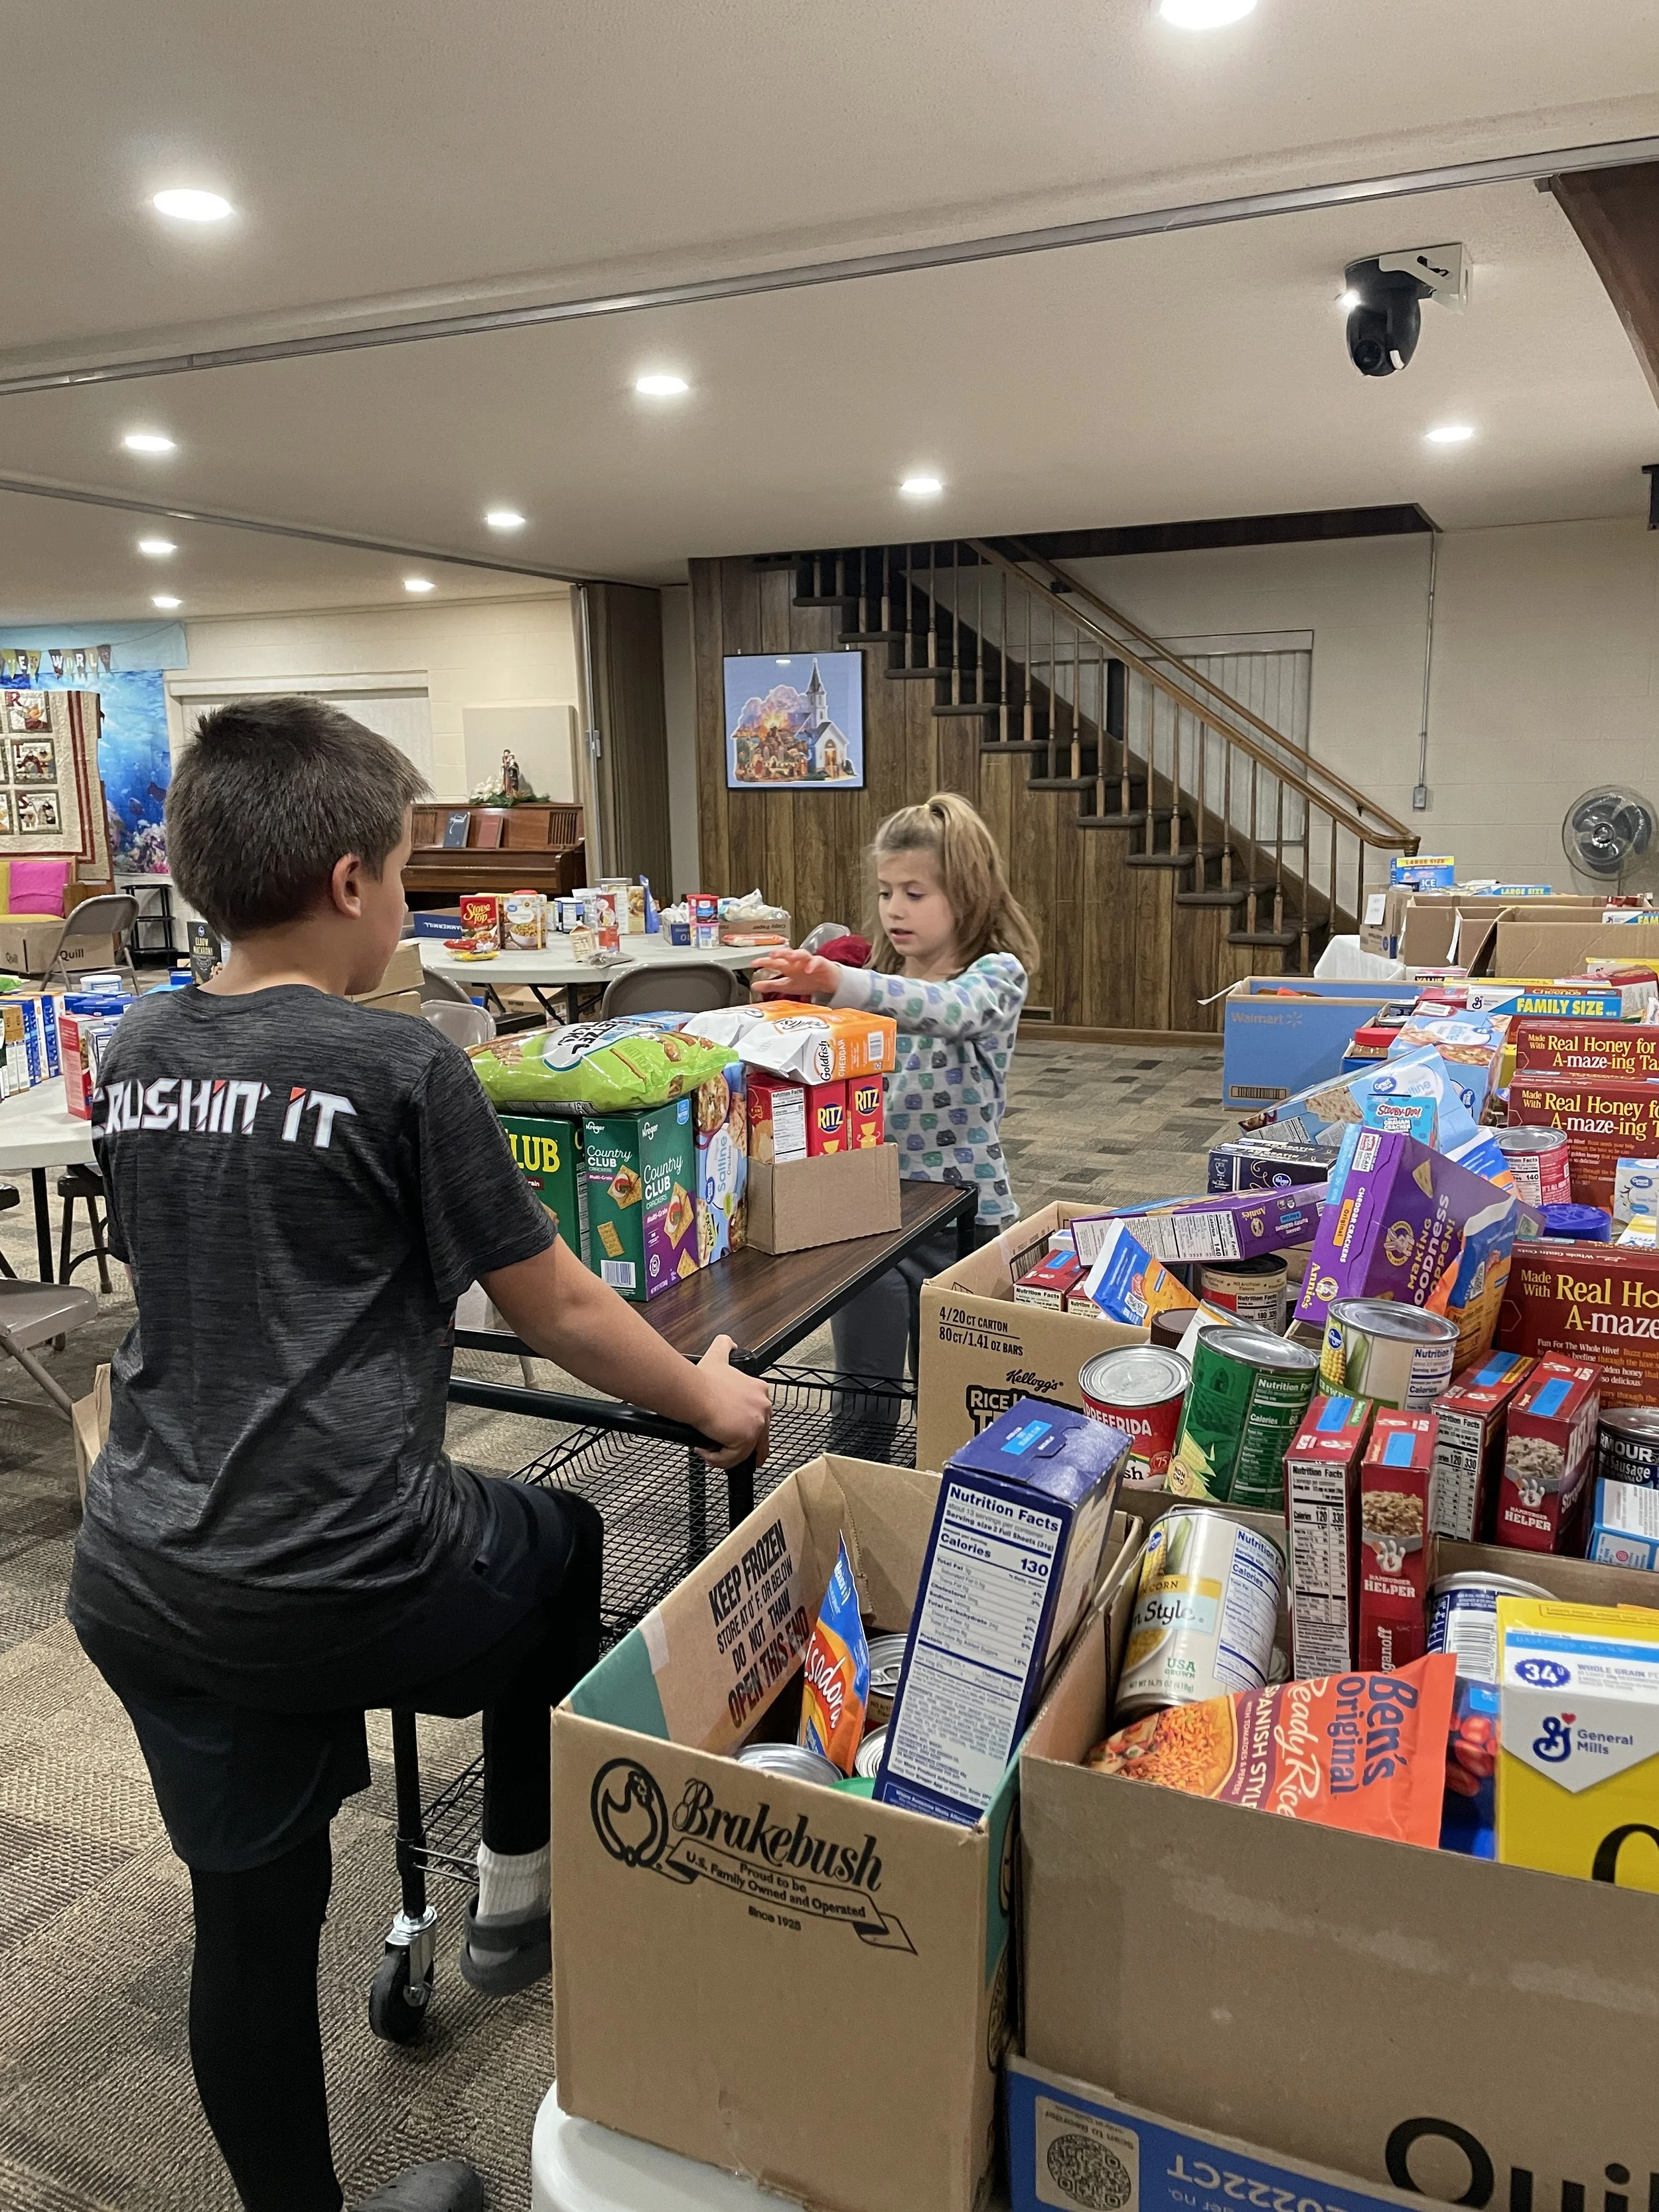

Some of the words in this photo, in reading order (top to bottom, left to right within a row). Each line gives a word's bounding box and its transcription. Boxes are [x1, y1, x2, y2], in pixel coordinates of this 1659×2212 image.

[463, 903, 491, 921] Stove
[473, 911, 488, 924] Top
[60, 950, 84, 962] Quill
[1517, 998, 1569, 1015] FAMILY
[1571, 1000, 1605, 1016] SIZE
[1231, 1012, 1283, 1024] Walmart
[1528, 1034, 1546, 1043] Made
[1530, 1041, 1546, 1050] With
[1548, 1035, 1579, 1052] Real
[1584, 1037, 1632, 1055] Honey
[1636, 1037, 1657, 1054] for
[820, 1040, 831, 1081] Goldfish
[1553, 1053, 1636, 1073] A-maze-ing
[855, 1088, 880, 1111] RITZ
[1522, 1090, 1542, 1100] Made
[1523, 1100, 1542, 1109] With
[1544, 1092, 1581, 1112] Real
[1587, 1096, 1645, 1120] Honey
[817, 1105, 843, 1129] RITZ
[1550, 1112, 1647, 1141] A-maze-ing
[585, 1121, 605, 1134] Kroger
[642, 1122, 658, 1140] Kroger
[506, 1129, 560, 1173] LUB
[587, 1145, 632, 1162] Country
[588, 1157, 616, 1167] CLUB
[644, 1155, 684, 1185] Country
[717, 1136, 727, 1192] Saltine
[644, 1175, 671, 1200] CLUB
[646, 1193, 668, 1210] CRACKERS
[1242, 1206, 1266, 1221] Annie's
[1336, 1209, 1349, 1238] Original
[1301, 1262, 1321, 1309] Annie's
[1521, 1269, 1552, 1284] Made
[1016, 1288, 1041, 1296] Nutrition
[1523, 1284, 1550, 1298] With
[1556, 1274, 1612, 1305] Real
[977, 1315, 1008, 1333] CARTON
[991, 1340, 1001, 1351] OZ
[1003, 1343, 1023, 1356] BARS
[1414, 1349, 1450, 1359] Nutrition
[1537, 1338, 1551, 1347] Fun
[1553, 1340, 1563, 1349] For
[1579, 1343, 1601, 1353] Whole
[1602, 1346, 1619, 1355] Hive!
[1006, 1369, 1060, 1393] Kellogg's
[1622, 1367, 1644, 1378] honey
[1258, 1378, 1299, 1392] Nutrition
[970, 1390, 1009, 1410] RICE
[1250, 1413, 1278, 1426] Calories
[1600, 1433, 1654, 1463] RMOUR
[1293, 1466, 1321, 1478] Nutrition
[1325, 1467, 1343, 1479] Facts
[1465, 1457, 1477, 1470] 330
[1610, 1455, 1651, 1483] Sausage
[950, 1486, 1014, 1518] Nutrition
[1018, 1508, 1059, 1532] Facts
[1316, 1511, 1327, 1523] 120
[1333, 1512, 1344, 1524] 330
[1510, 1507, 1548, 1520] HAMBURGER
[1504, 1510, 1551, 1532] HELPER
[940, 1532, 991, 1558] Calories
[1020, 1558, 1048, 1576] 130
[1237, 1530, 1275, 1558] Nutrition
[709, 1564, 741, 1627] KEEP
[741, 1518, 787, 1591] FROZEN
[1232, 1564, 1263, 1587] Calories
[1369, 1574, 1411, 1586] HAMBURGER
[1364, 1579, 1415, 1599] HELPER
[717, 1615, 741, 1655] STORE
[740, 1606, 749, 1631] AT
[761, 1580, 772, 1601] OR
[770, 1554, 794, 1593] BELOW
[1144, 1600, 1196, 1625] Style
[732, 1641, 747, 1675] DO
[749, 1619, 766, 1655] NOT
[767, 1585, 792, 1629] THAW
[1377, 1626, 1396, 1674] ganoff
[728, 1666, 764, 1729] OPEN
[759, 1631, 789, 1688] THIS
[784, 1604, 810, 1656] END
[1165, 1669, 1196, 1678] GROWN
[1167, 1658, 1196, 1673] USA
[1577, 1663, 1613, 1676] WHOLE
[1614, 1668, 1646, 1678] GRAIN
[804, 1631, 846, 1729] Isadora
[1174, 1681, 1194, 1692] (418g)
[1252, 1684, 1281, 1759] SPANISH
[1362, 1674, 1419, 1787] Ben's
[1241, 1720, 1252, 1757] TOMATOES
[1327, 1676, 1366, 1795] Original
[1577, 1729, 1634, 1746] General
[1577, 1741, 1610, 1755] Mills
[1232, 1762, 1246, 1796] PEPPERS
[672, 1777, 883, 1892] Brakebush
[685, 1850, 708, 1873] U.S.
[710, 1862, 747, 1891] Family
[748, 1878, 787, 1903] Owned
[789, 1891, 810, 1908] and
[811, 1895, 867, 1921] Operated
[740, 1862, 775, 1885] Proud
[777, 1876, 791, 1889] to
[792, 1878, 808, 1893] be
[747, 1905, 776, 1923] Since
[1385, 2116, 1659, 2212] Qui
[1167, 2154, 1358, 2212] 0222CT
